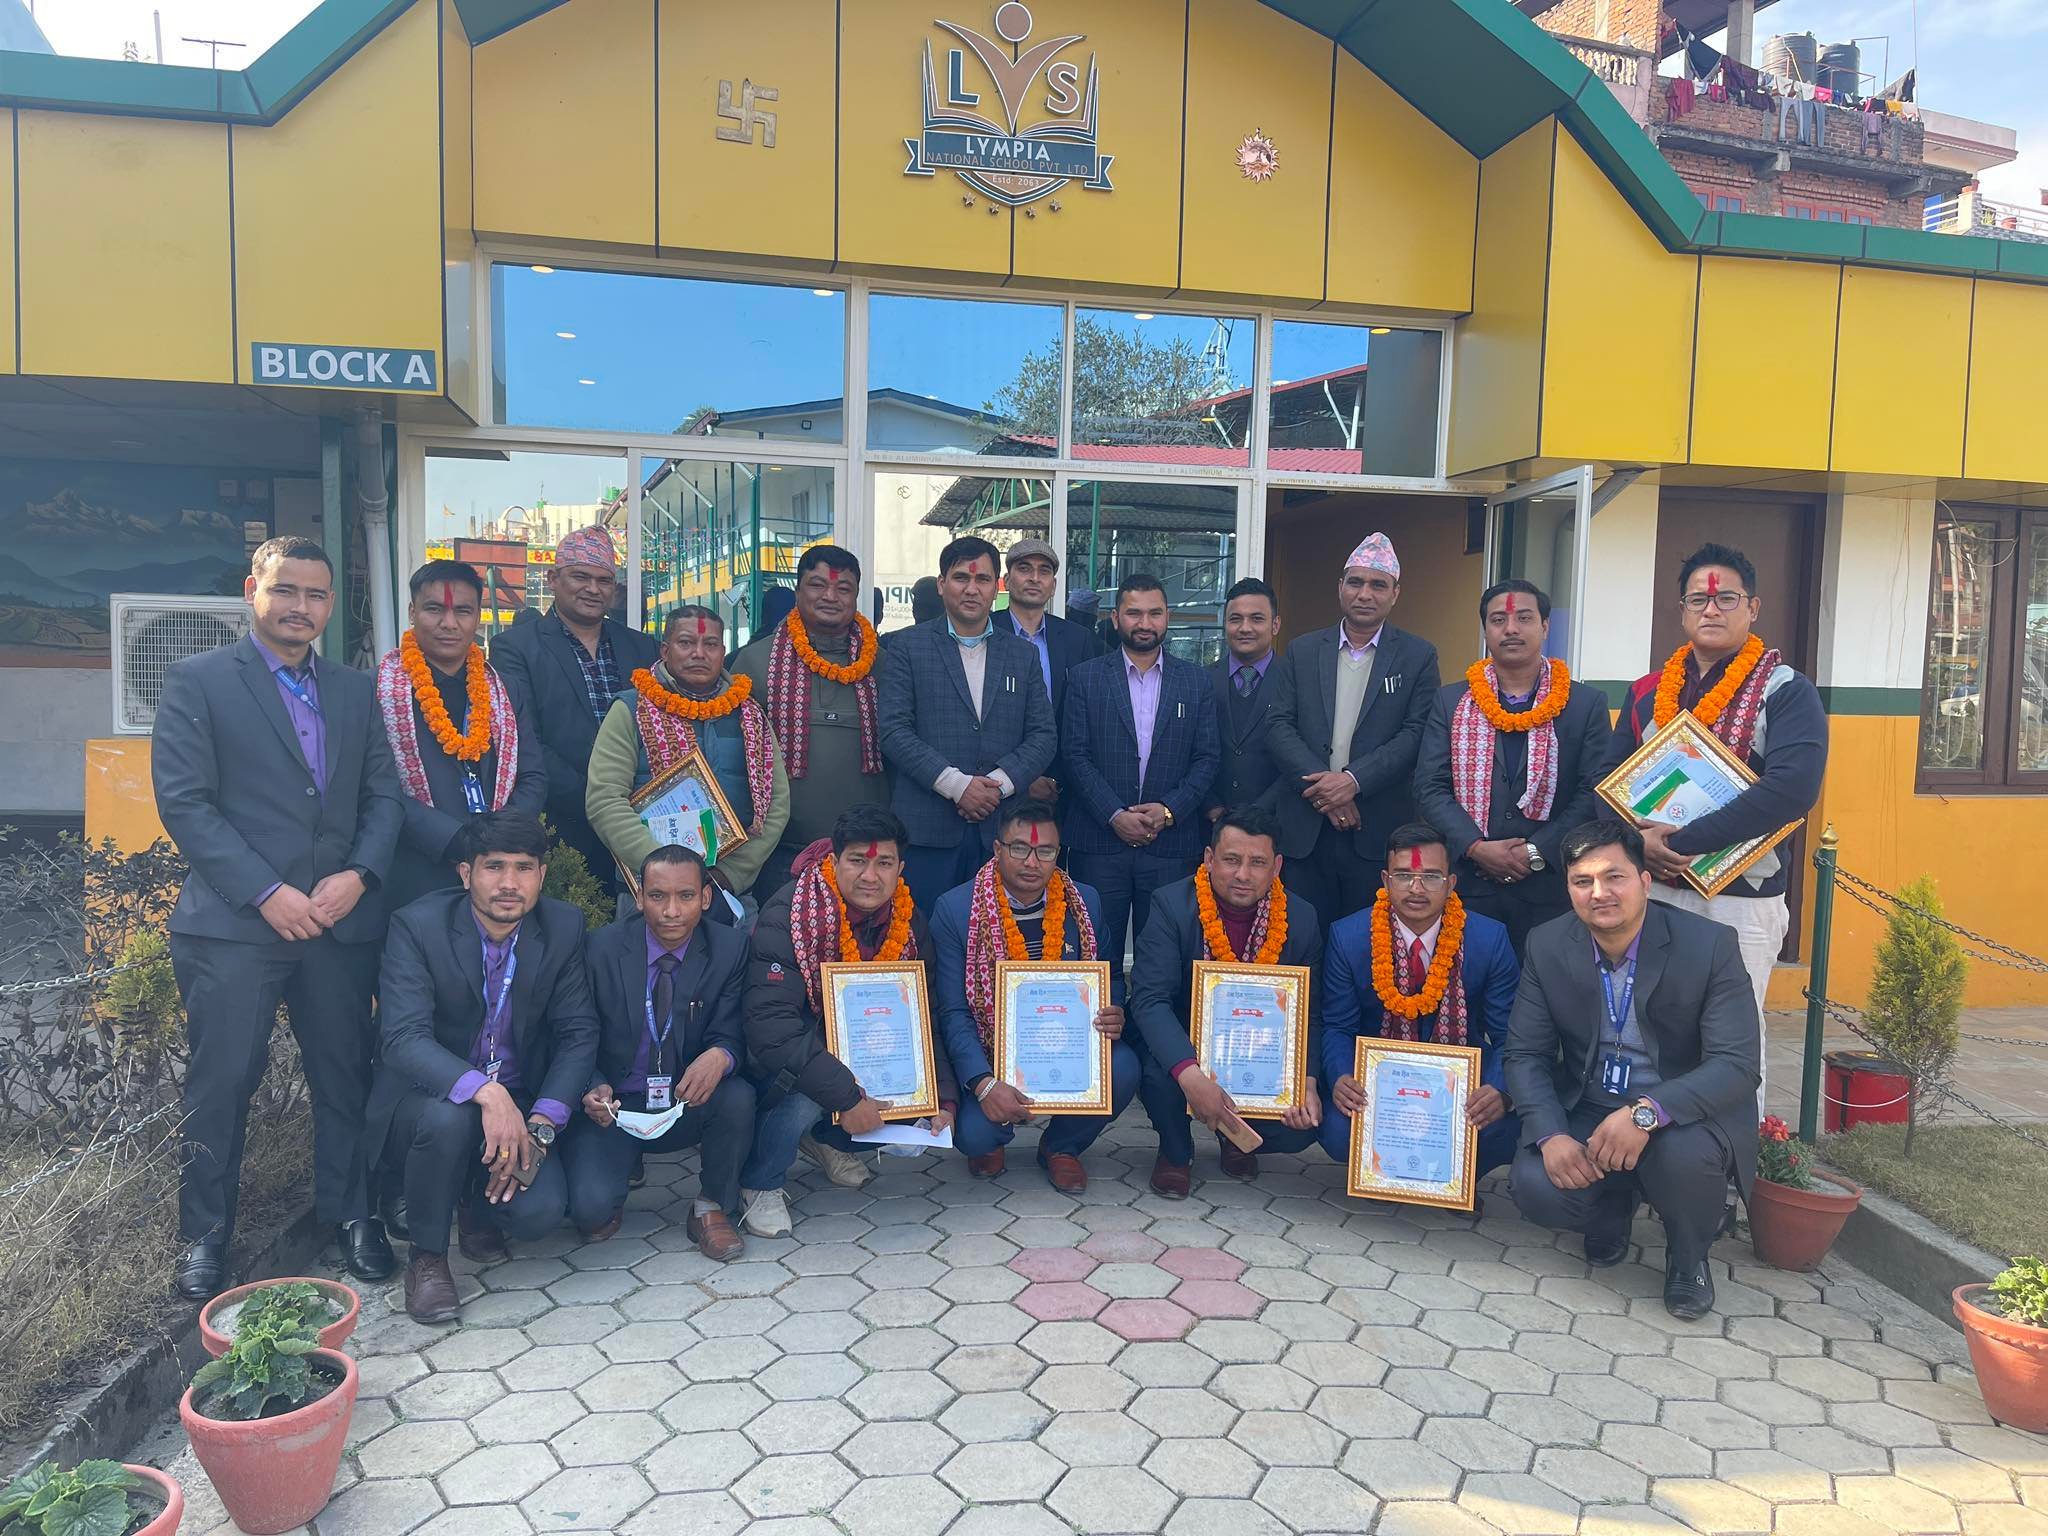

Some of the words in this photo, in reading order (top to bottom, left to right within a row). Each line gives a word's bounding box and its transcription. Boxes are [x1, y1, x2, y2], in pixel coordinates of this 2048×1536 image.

[948, 49, 981, 106] L
[1046, 62, 1081, 114] S
[926, 151, 985, 167] NATIONAL
[989, 157, 1035, 171] SCHOOL
[966, 136, 1050, 161] LYMPIA
[261, 347, 392, 383] BLOCK
[402, 354, 432, 385] A
[967, 922, 980, 964] NEPAL
[991, 918, 1006, 961] NEPAL
